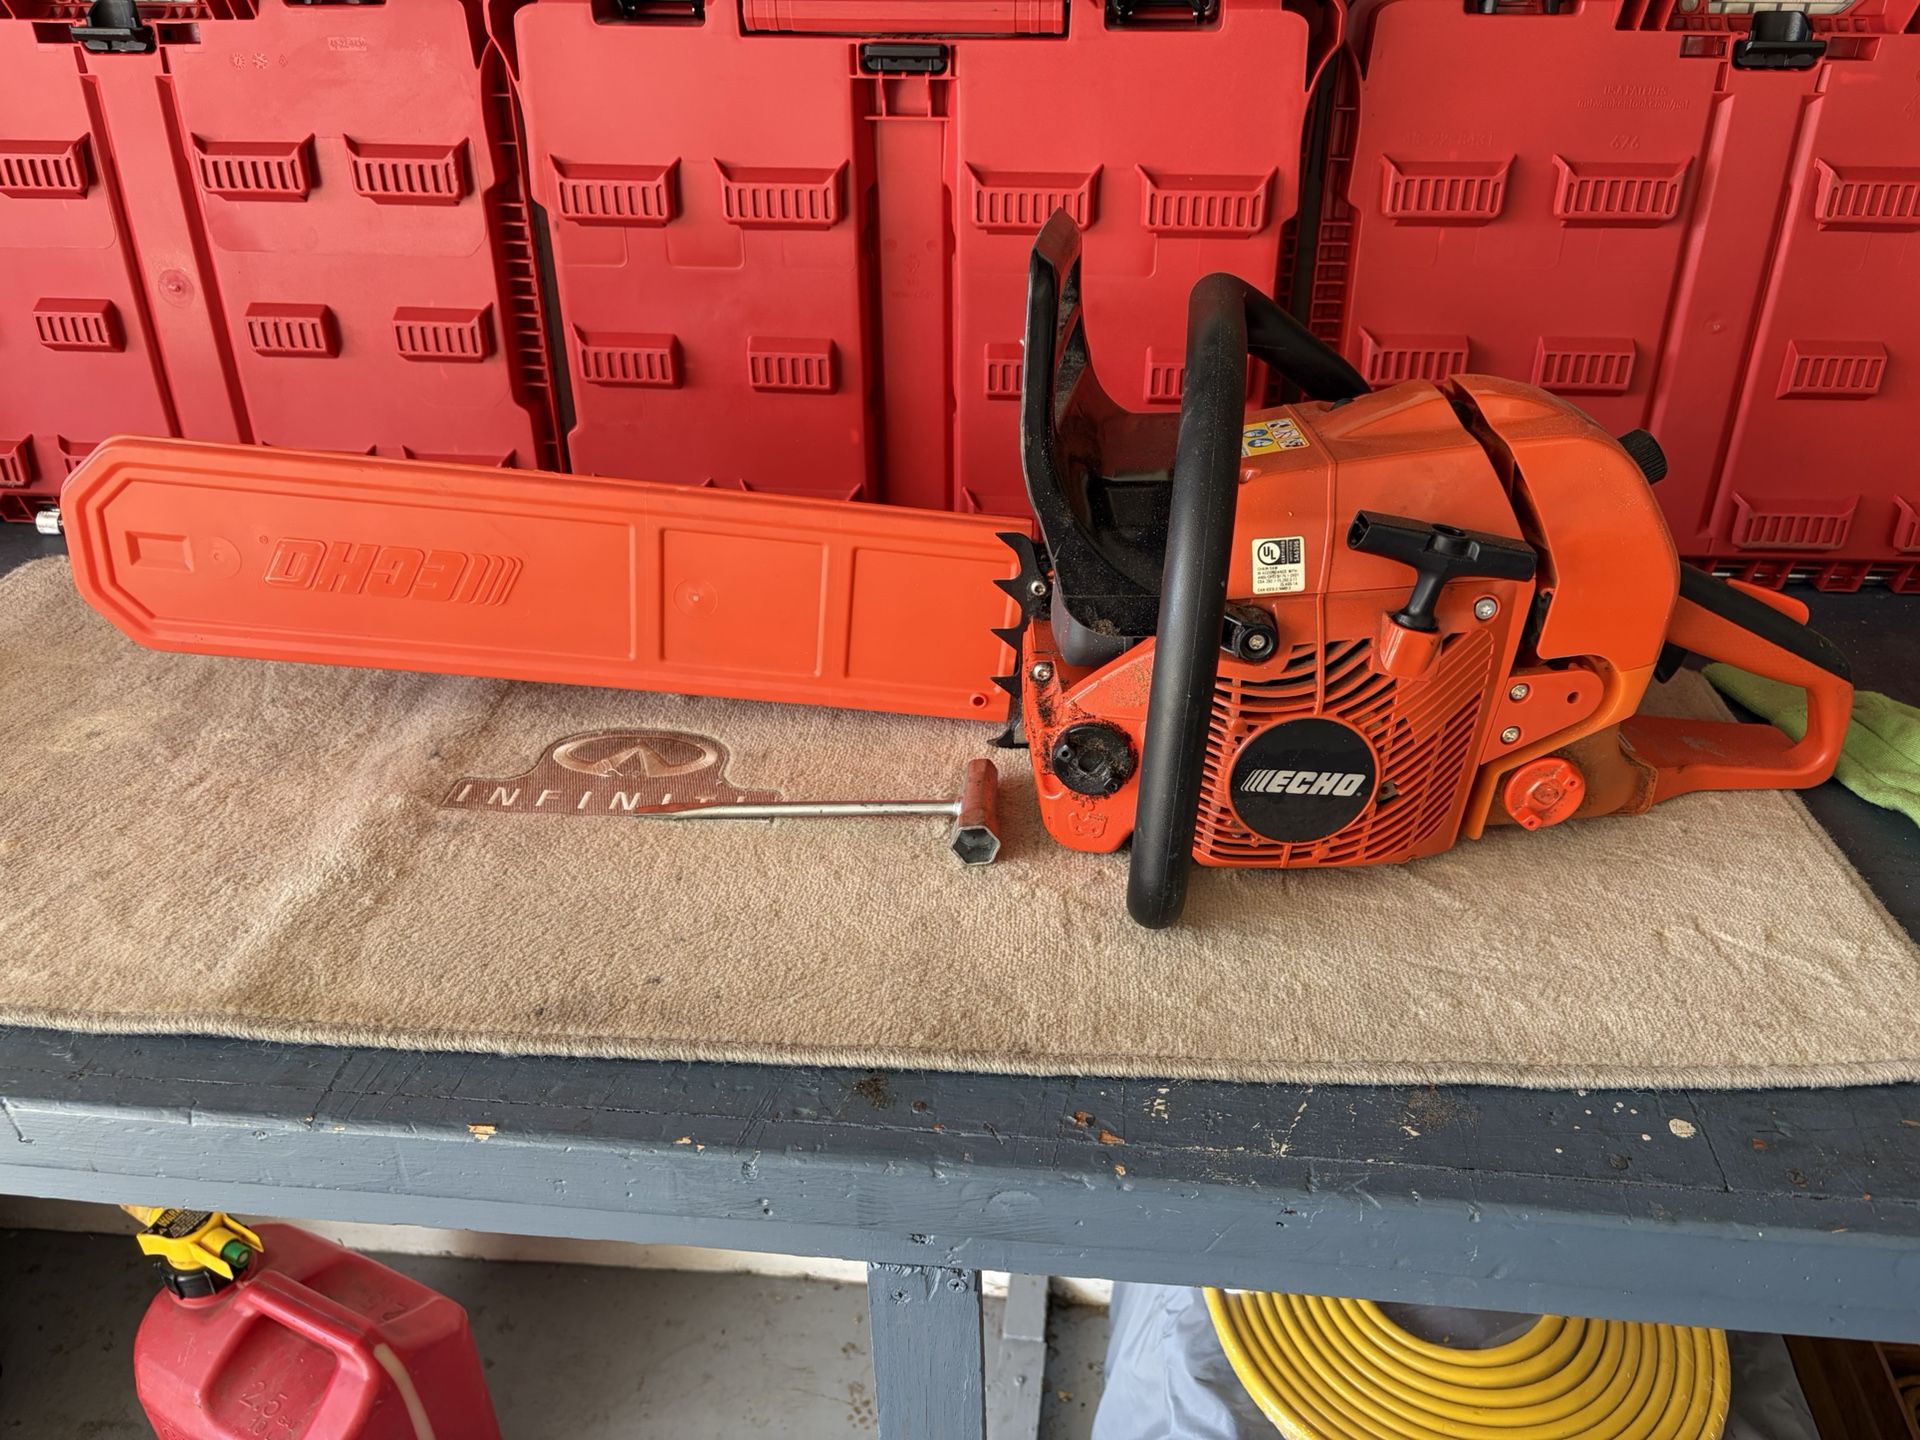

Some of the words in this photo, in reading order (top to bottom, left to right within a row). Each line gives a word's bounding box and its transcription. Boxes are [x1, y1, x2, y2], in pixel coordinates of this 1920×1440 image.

[1263, 546, 1277, 560] UL
[264, 536, 469, 602] ECHO
[1264, 770, 1367, 797] ECHO
[456, 784, 746, 811] INFINI
[239, 1381, 289, 1419] 2.5
